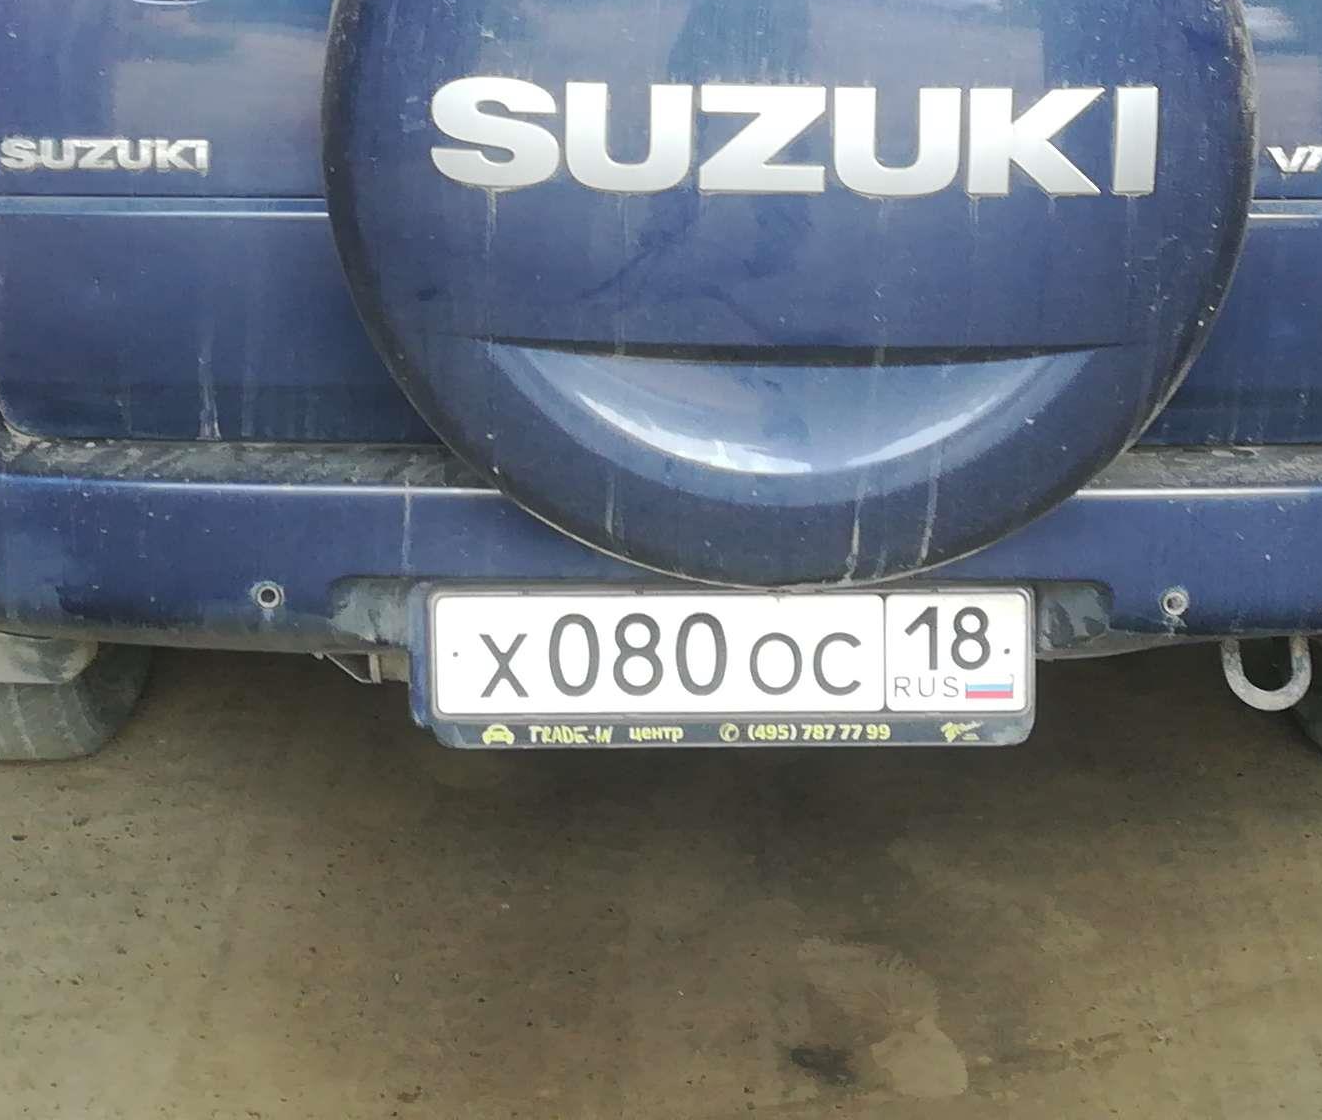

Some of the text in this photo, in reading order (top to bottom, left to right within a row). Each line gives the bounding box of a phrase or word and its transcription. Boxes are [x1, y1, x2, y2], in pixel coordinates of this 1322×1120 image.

[430, 76, 1159, 195] SUZUKI
[0, 137, 209, 173] SUZUKI
[905, 606, 991, 670] 18
[894, 676, 960, 698] RUS
[629, 726, 684, 743] центр
[747, 723, 798, 741] (495)
[801, 723, 837, 741] 787
[838, 723, 864, 741] 77
[865, 723, 892, 741] 99
